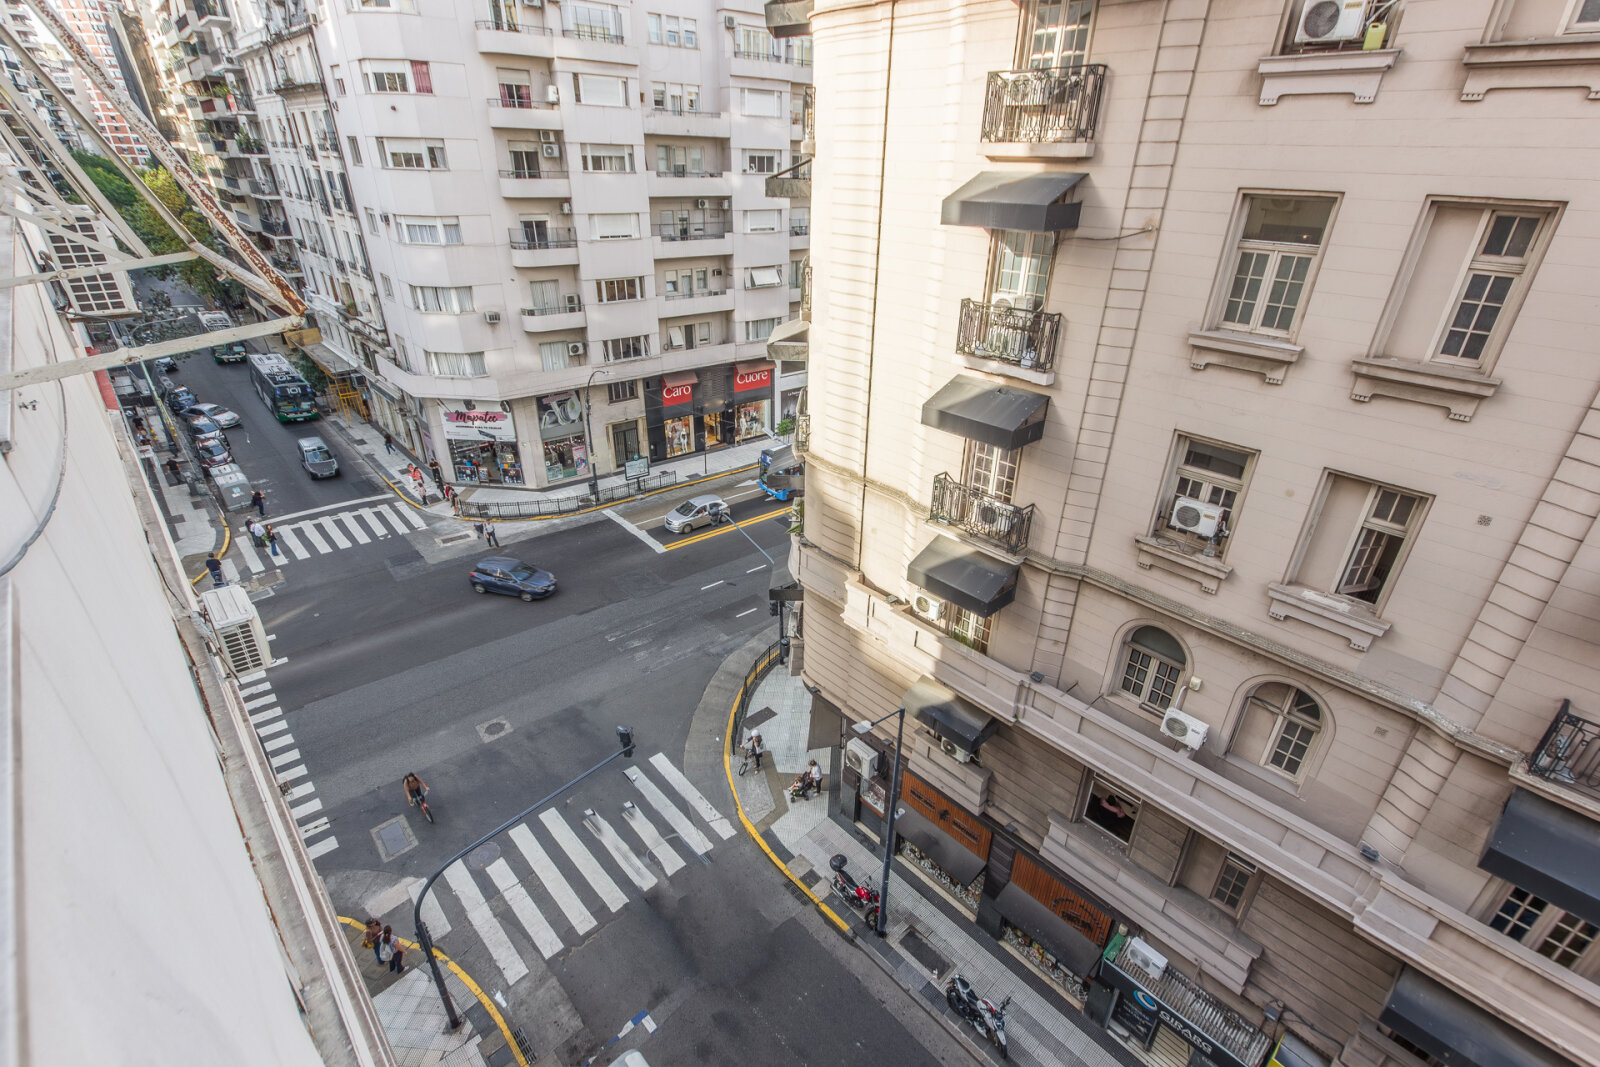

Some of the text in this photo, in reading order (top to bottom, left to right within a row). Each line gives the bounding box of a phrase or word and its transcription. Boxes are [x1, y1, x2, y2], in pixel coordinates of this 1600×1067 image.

[736, 370, 768, 384] Cuore
[663, 385, 691, 399] Caro
[1159, 1010, 1212, 1054] GIRARG
